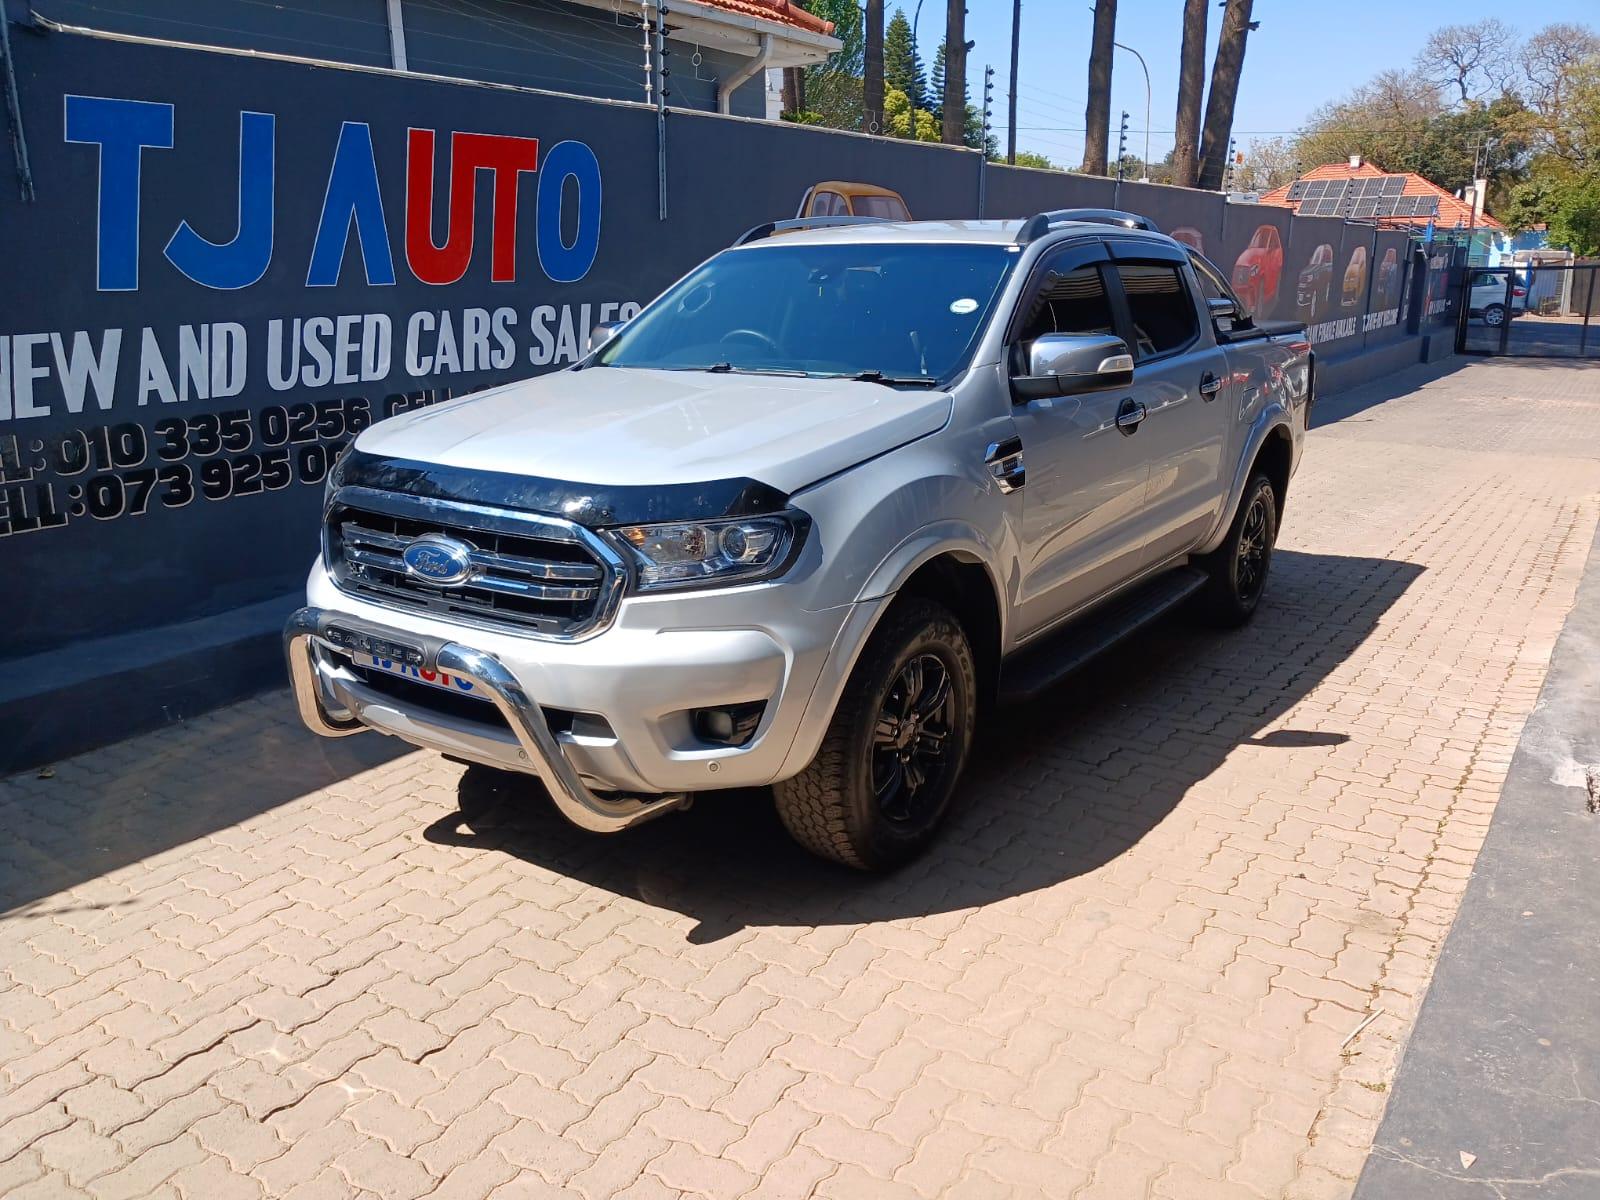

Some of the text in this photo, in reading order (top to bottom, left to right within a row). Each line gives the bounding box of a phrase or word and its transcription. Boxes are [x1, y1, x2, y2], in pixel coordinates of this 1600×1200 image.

[63, 93, 602, 291] TJ AUTO
[138, 322, 248, 406] AND
[267, 313, 392, 391] USED
[405, 307, 518, 377] CARS
[154, 408, 254, 462] 335
[260, 397, 371, 447] 0256
[201, 449, 292, 501] 925
[414, 549, 450, 575] Ford
